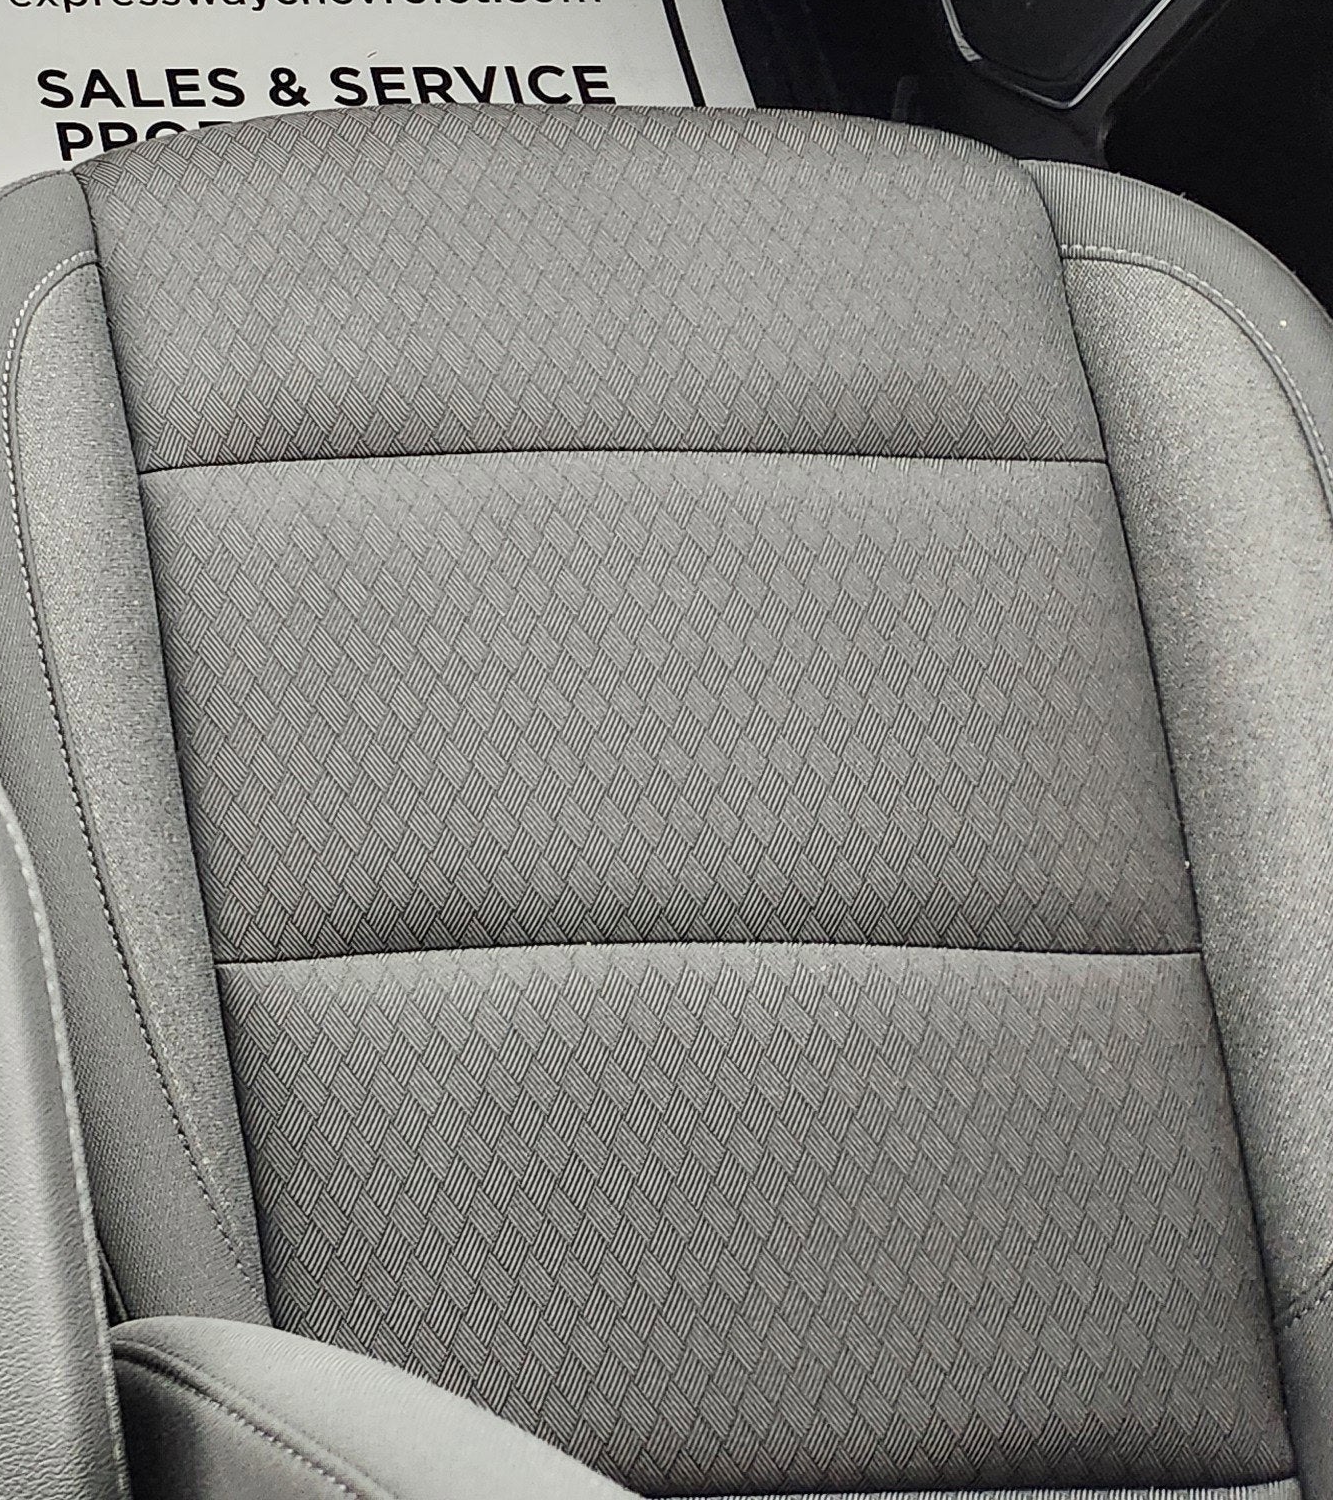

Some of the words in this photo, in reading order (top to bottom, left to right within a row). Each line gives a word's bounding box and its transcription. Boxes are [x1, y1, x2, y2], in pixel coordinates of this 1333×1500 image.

[38, 68, 244, 108] SALES
[269, 68, 310, 107] &
[332, 63, 616, 106] SERVICE
